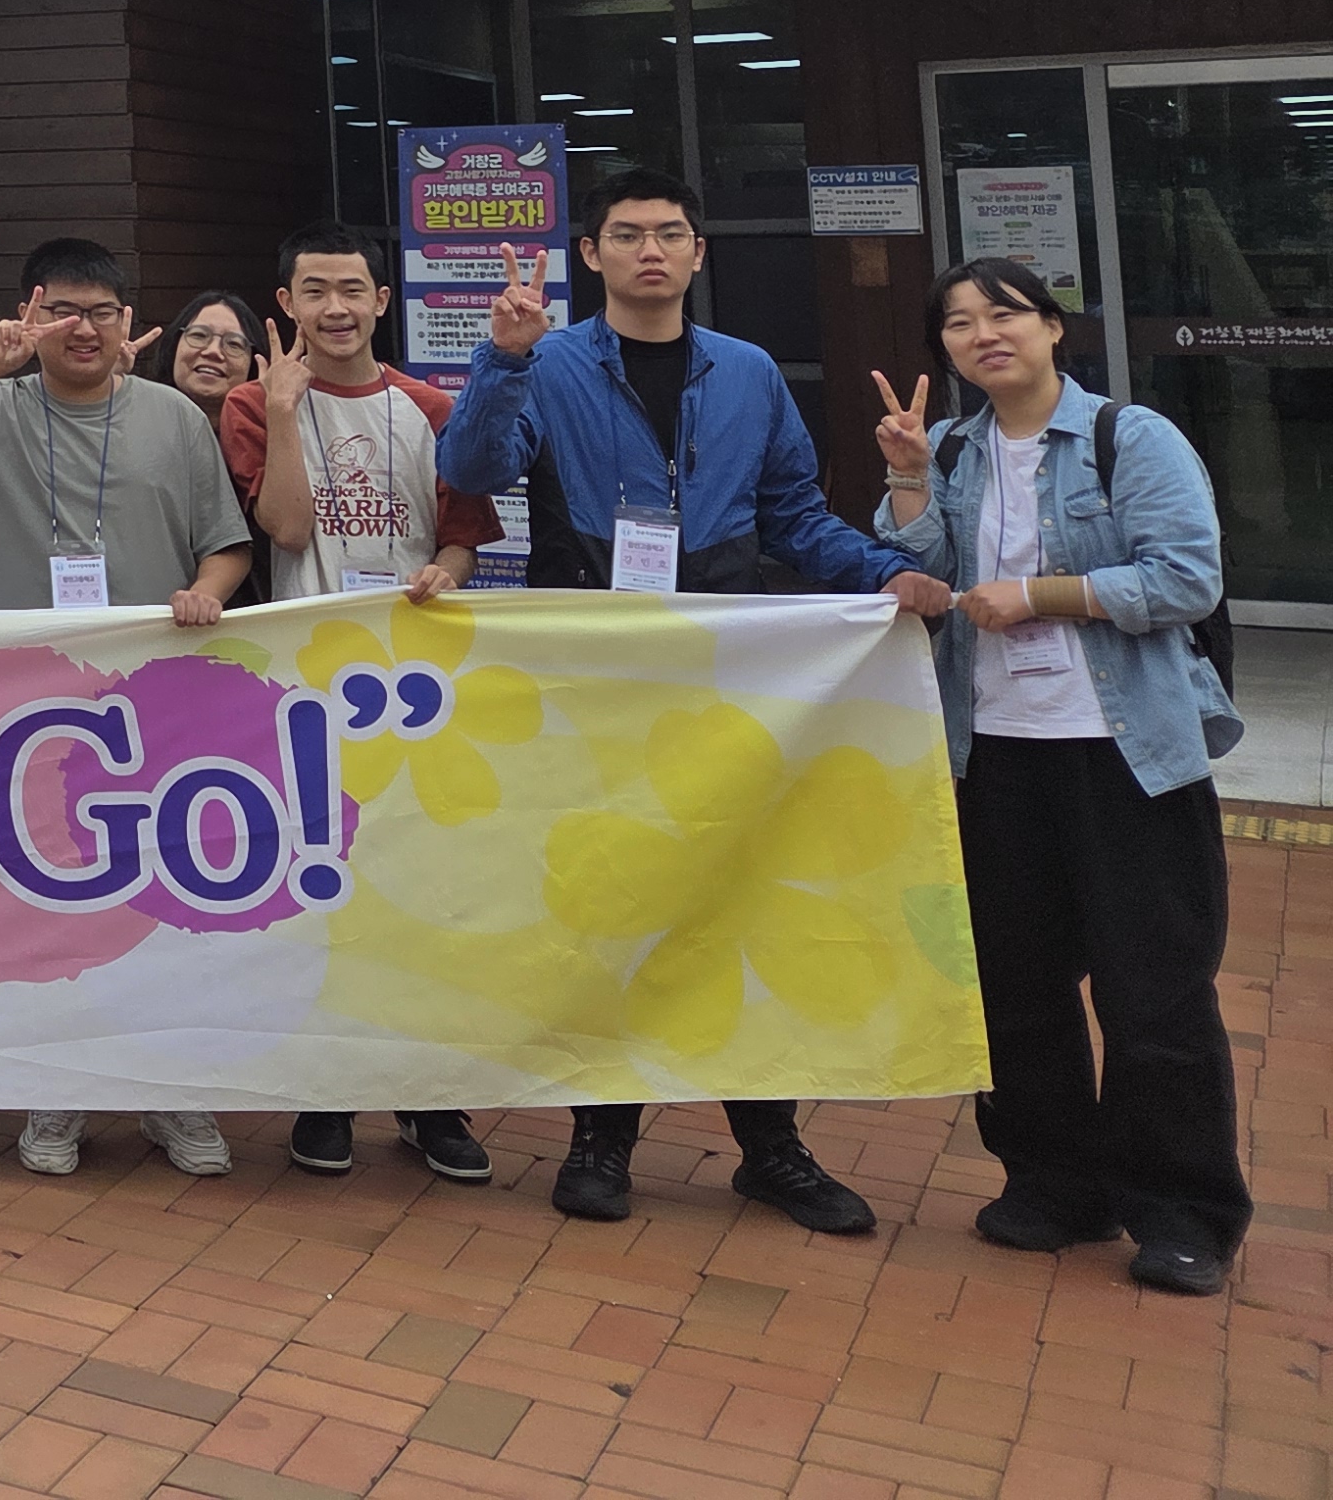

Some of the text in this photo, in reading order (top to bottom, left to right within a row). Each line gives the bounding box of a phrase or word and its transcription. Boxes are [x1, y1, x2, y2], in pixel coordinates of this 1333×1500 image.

[461, 153, 503, 169] 거창군
[871, 170, 898, 183] 안내
[491, 181, 545, 197] 보여주고
[423, 198, 546, 230] 할인받자!
